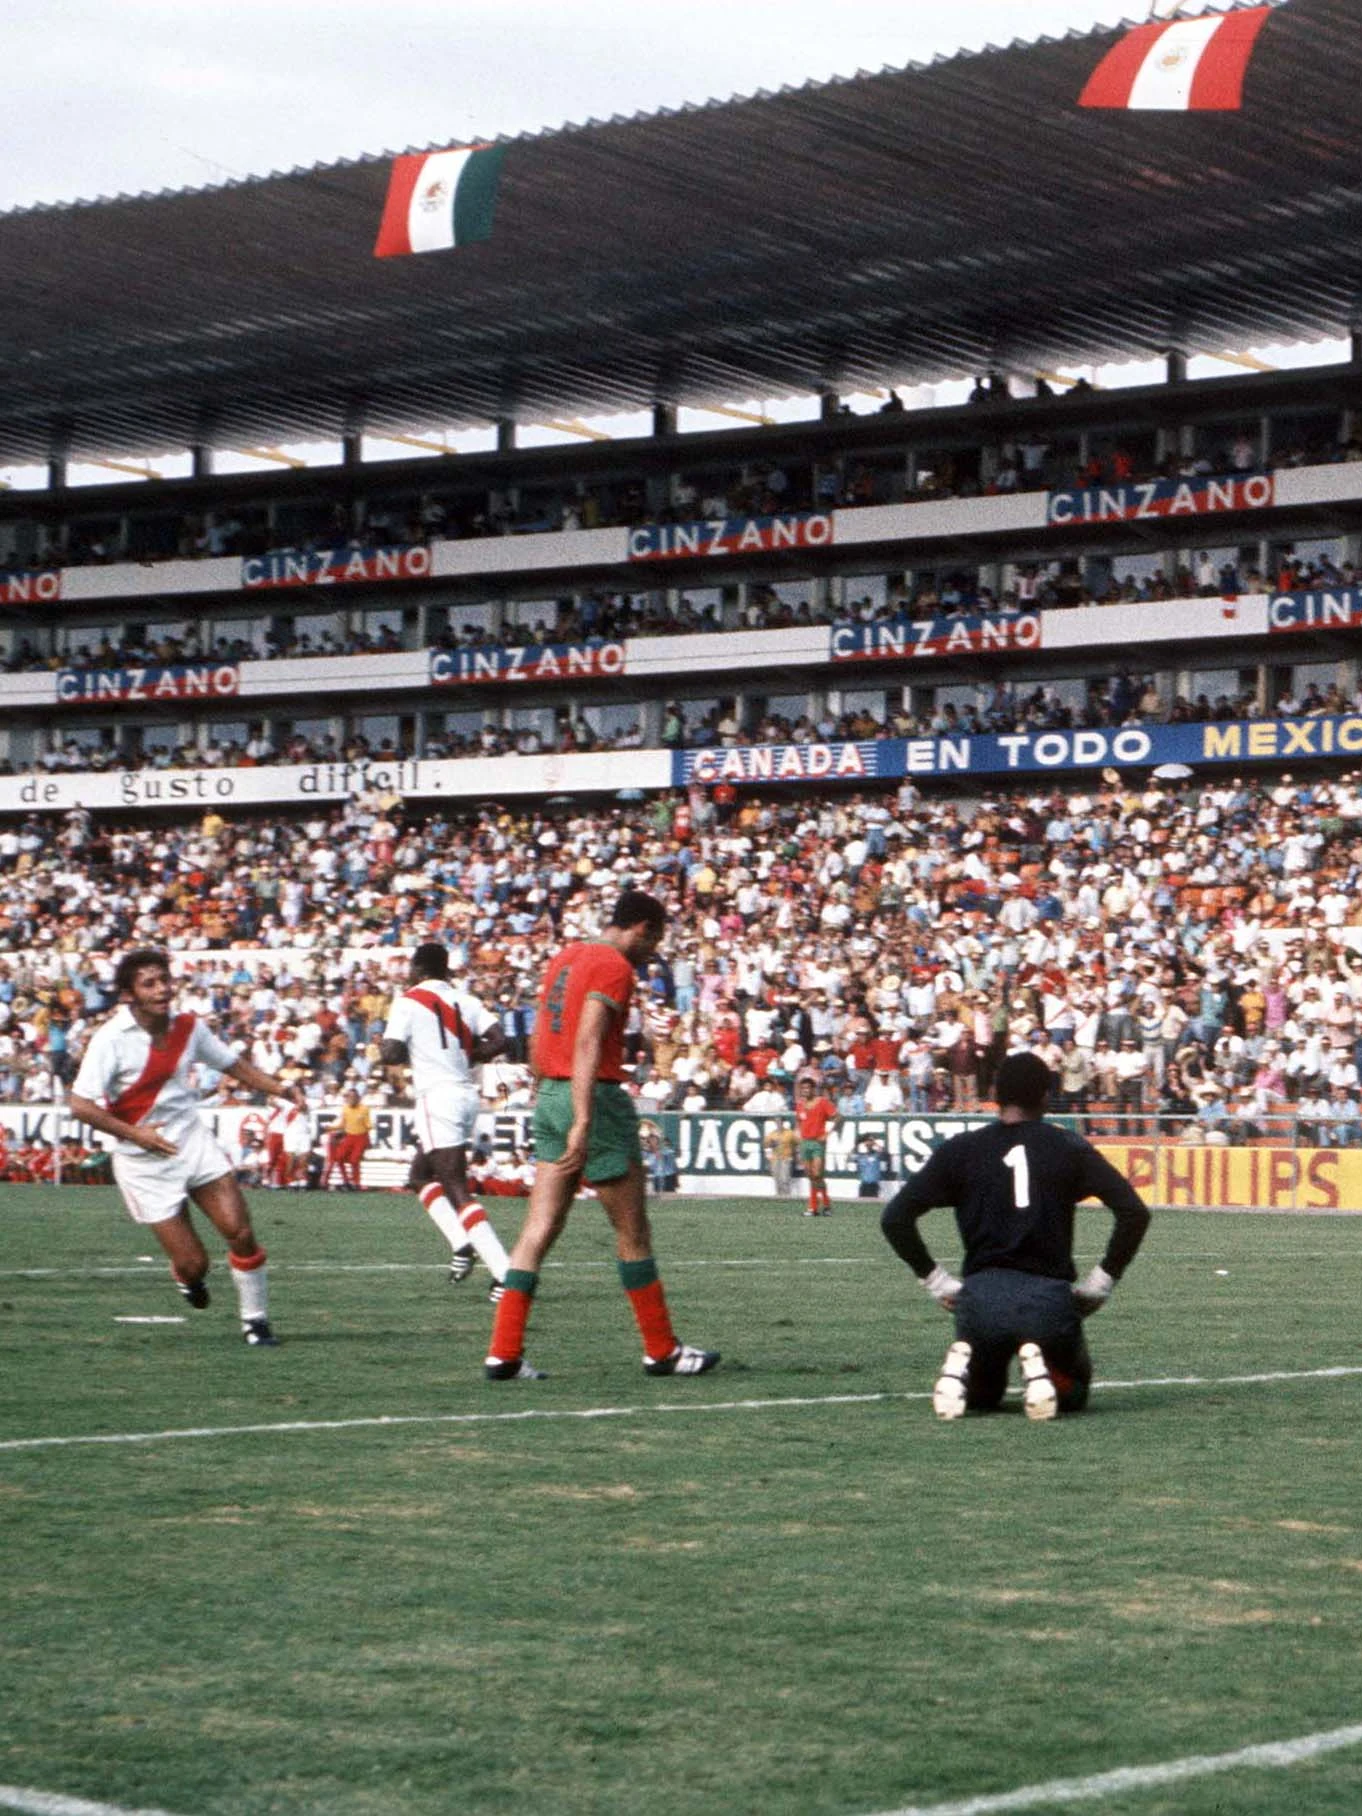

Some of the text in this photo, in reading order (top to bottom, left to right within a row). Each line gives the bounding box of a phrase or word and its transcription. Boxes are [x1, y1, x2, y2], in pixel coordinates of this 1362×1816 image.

[1051, 475, 1270, 523] CINZANO
[629, 515, 831, 557] CINZANO
[0, 572, 58, 600] NO
[243, 546, 430, 586] CINZANO
[832, 615, 1041, 657] CINZANO
[58, 665, 238, 699] CINZANO
[432, 643, 624, 682] CINZANO
[693, 743, 867, 783] CANADA
[906, 738, 971, 772] EN
[998, 730, 1152, 768] TODO
[20, 779, 59, 803] de
[121, 772, 235, 804] gusto
[431, 1001, 465, 1049] 11
[1003, 1143, 1031, 1209] 1
[1127, 1148, 1340, 1209] PHILIPS
